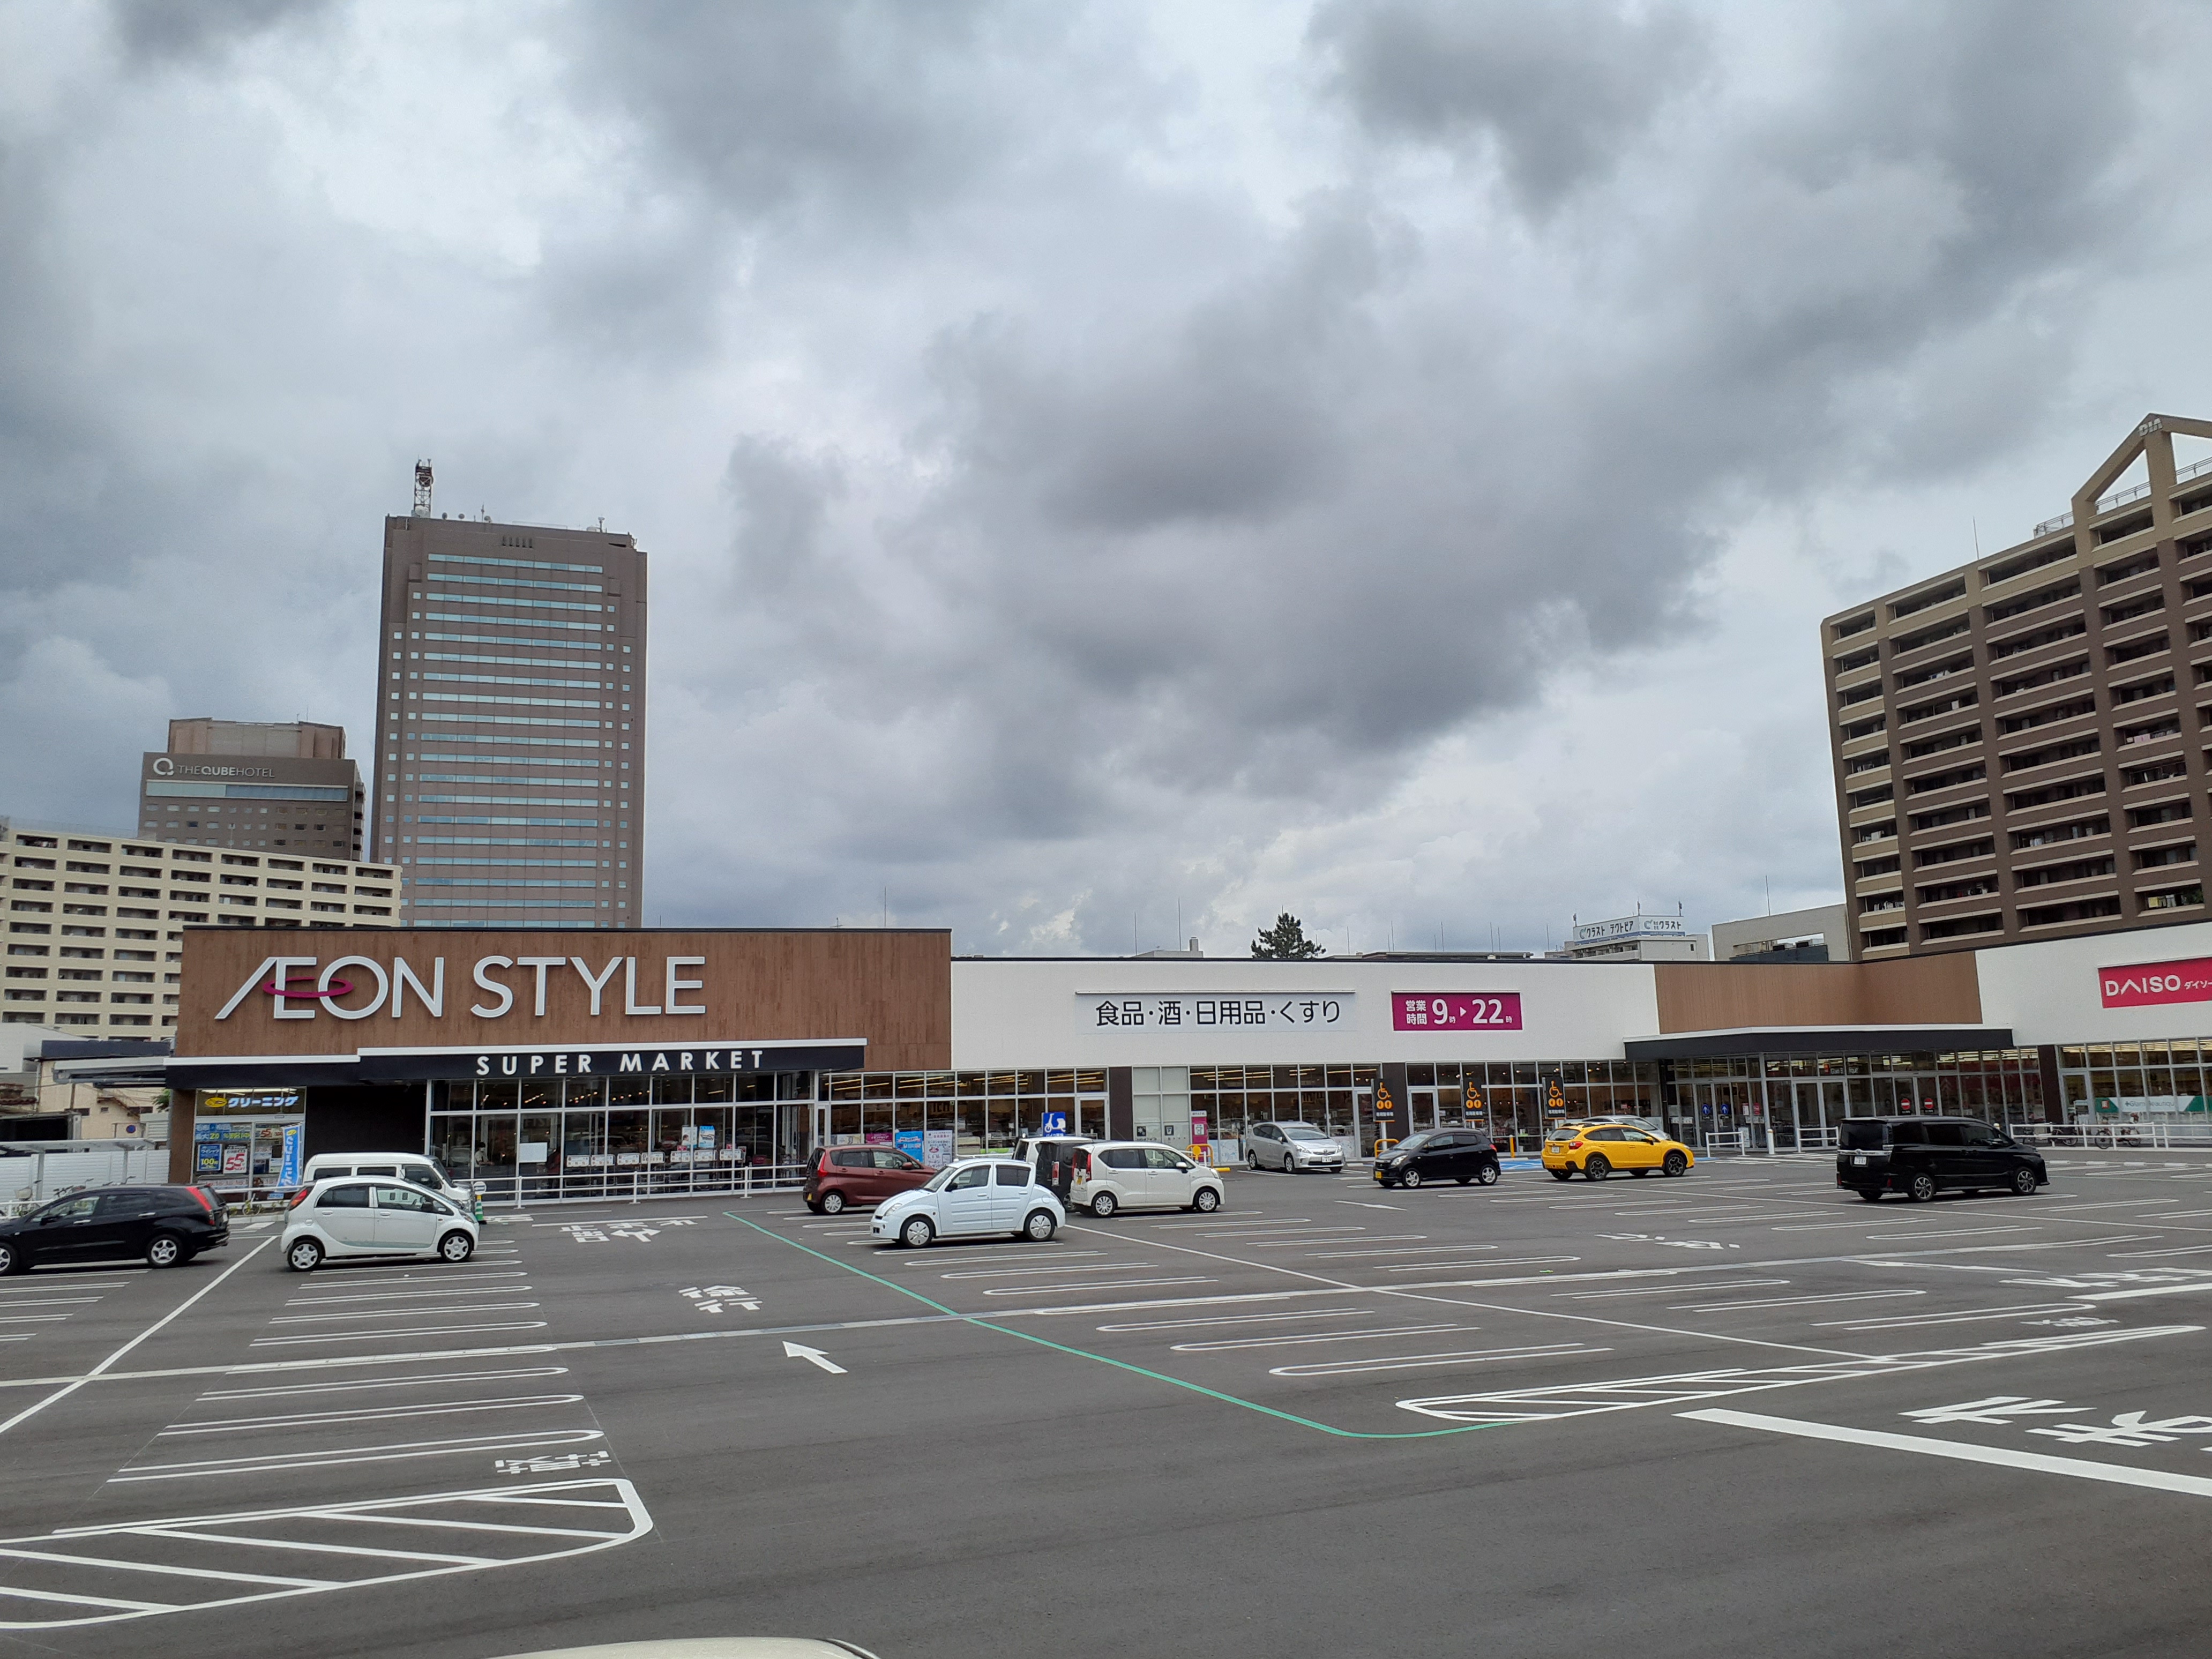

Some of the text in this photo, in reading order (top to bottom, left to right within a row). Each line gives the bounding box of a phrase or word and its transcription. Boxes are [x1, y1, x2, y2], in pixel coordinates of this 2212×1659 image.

[470, 955, 706, 1019] STYLE
[2105, 974, 2181, 997] DAISO
[1406, 999, 1426, 1012] 営業
[1406, 1013, 1428, 1025] 時間
[476, 1049, 764, 1076] SUPER MARKET
[228, 1096, 299, 1108] クリーニング
[559, 1220, 698, 1232] 止まれ
[571, 1230, 610, 1243] 出口
[678, 1285, 763, 1313] 徐行
